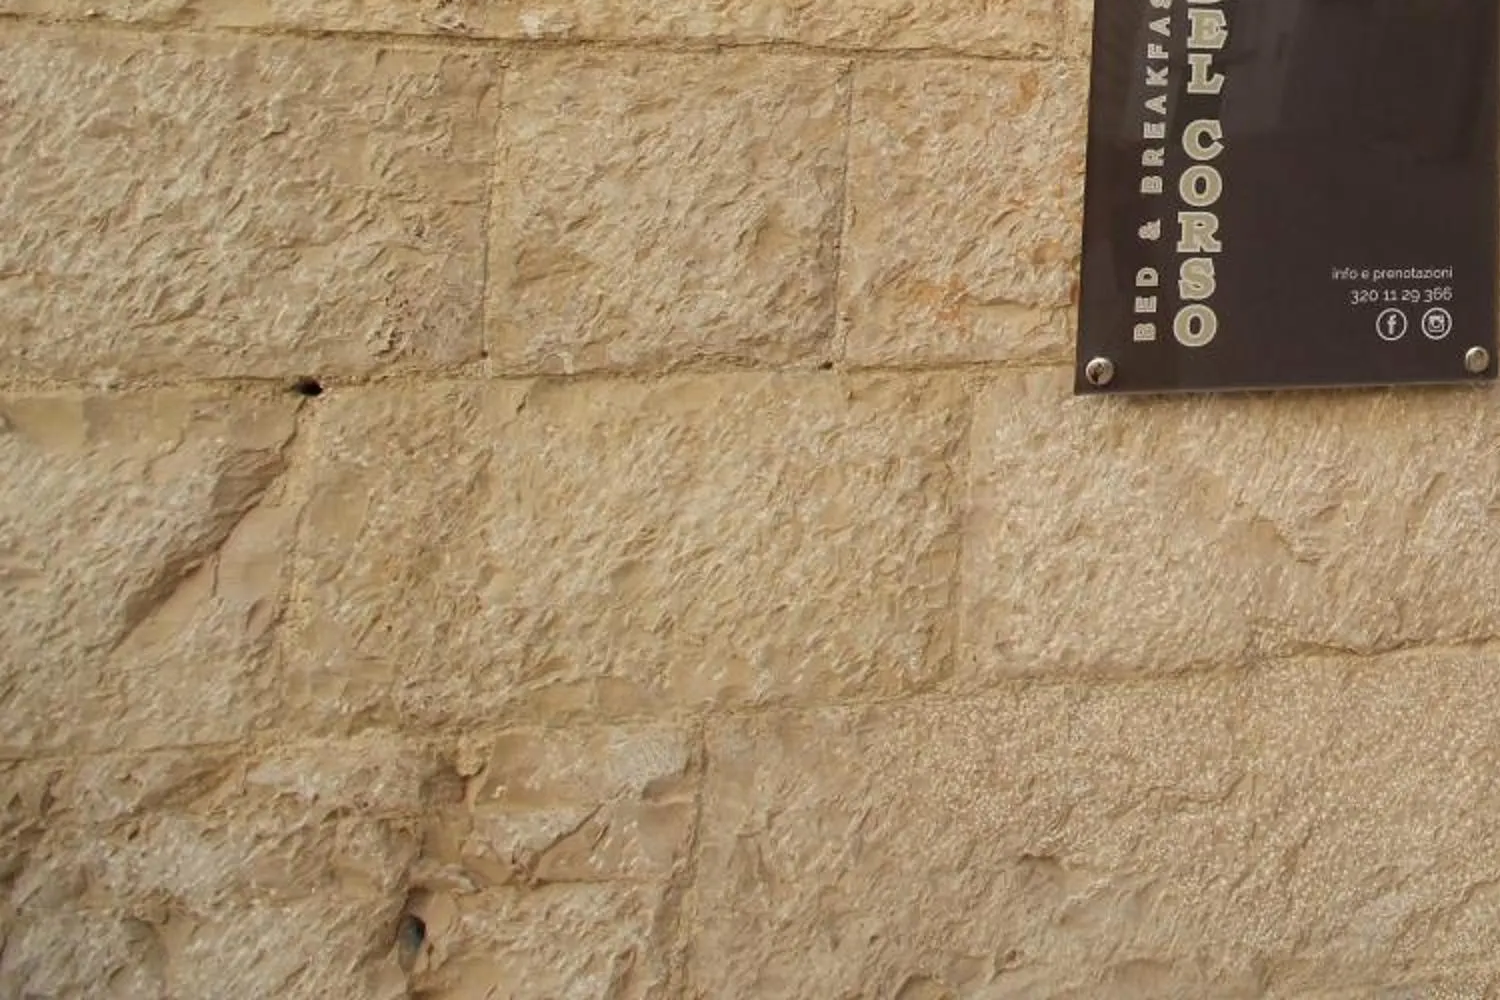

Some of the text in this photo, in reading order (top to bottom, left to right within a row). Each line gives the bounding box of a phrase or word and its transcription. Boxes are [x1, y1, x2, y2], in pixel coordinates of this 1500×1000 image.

[1137, 217, 1162, 241] &
[1172, 118, 1225, 348] CORSO
[1331, 265, 1453, 283] info e prenotazioni
[1132, 266, 1159, 343] BED
[1350, 286, 1453, 305] 320 11 29 366
